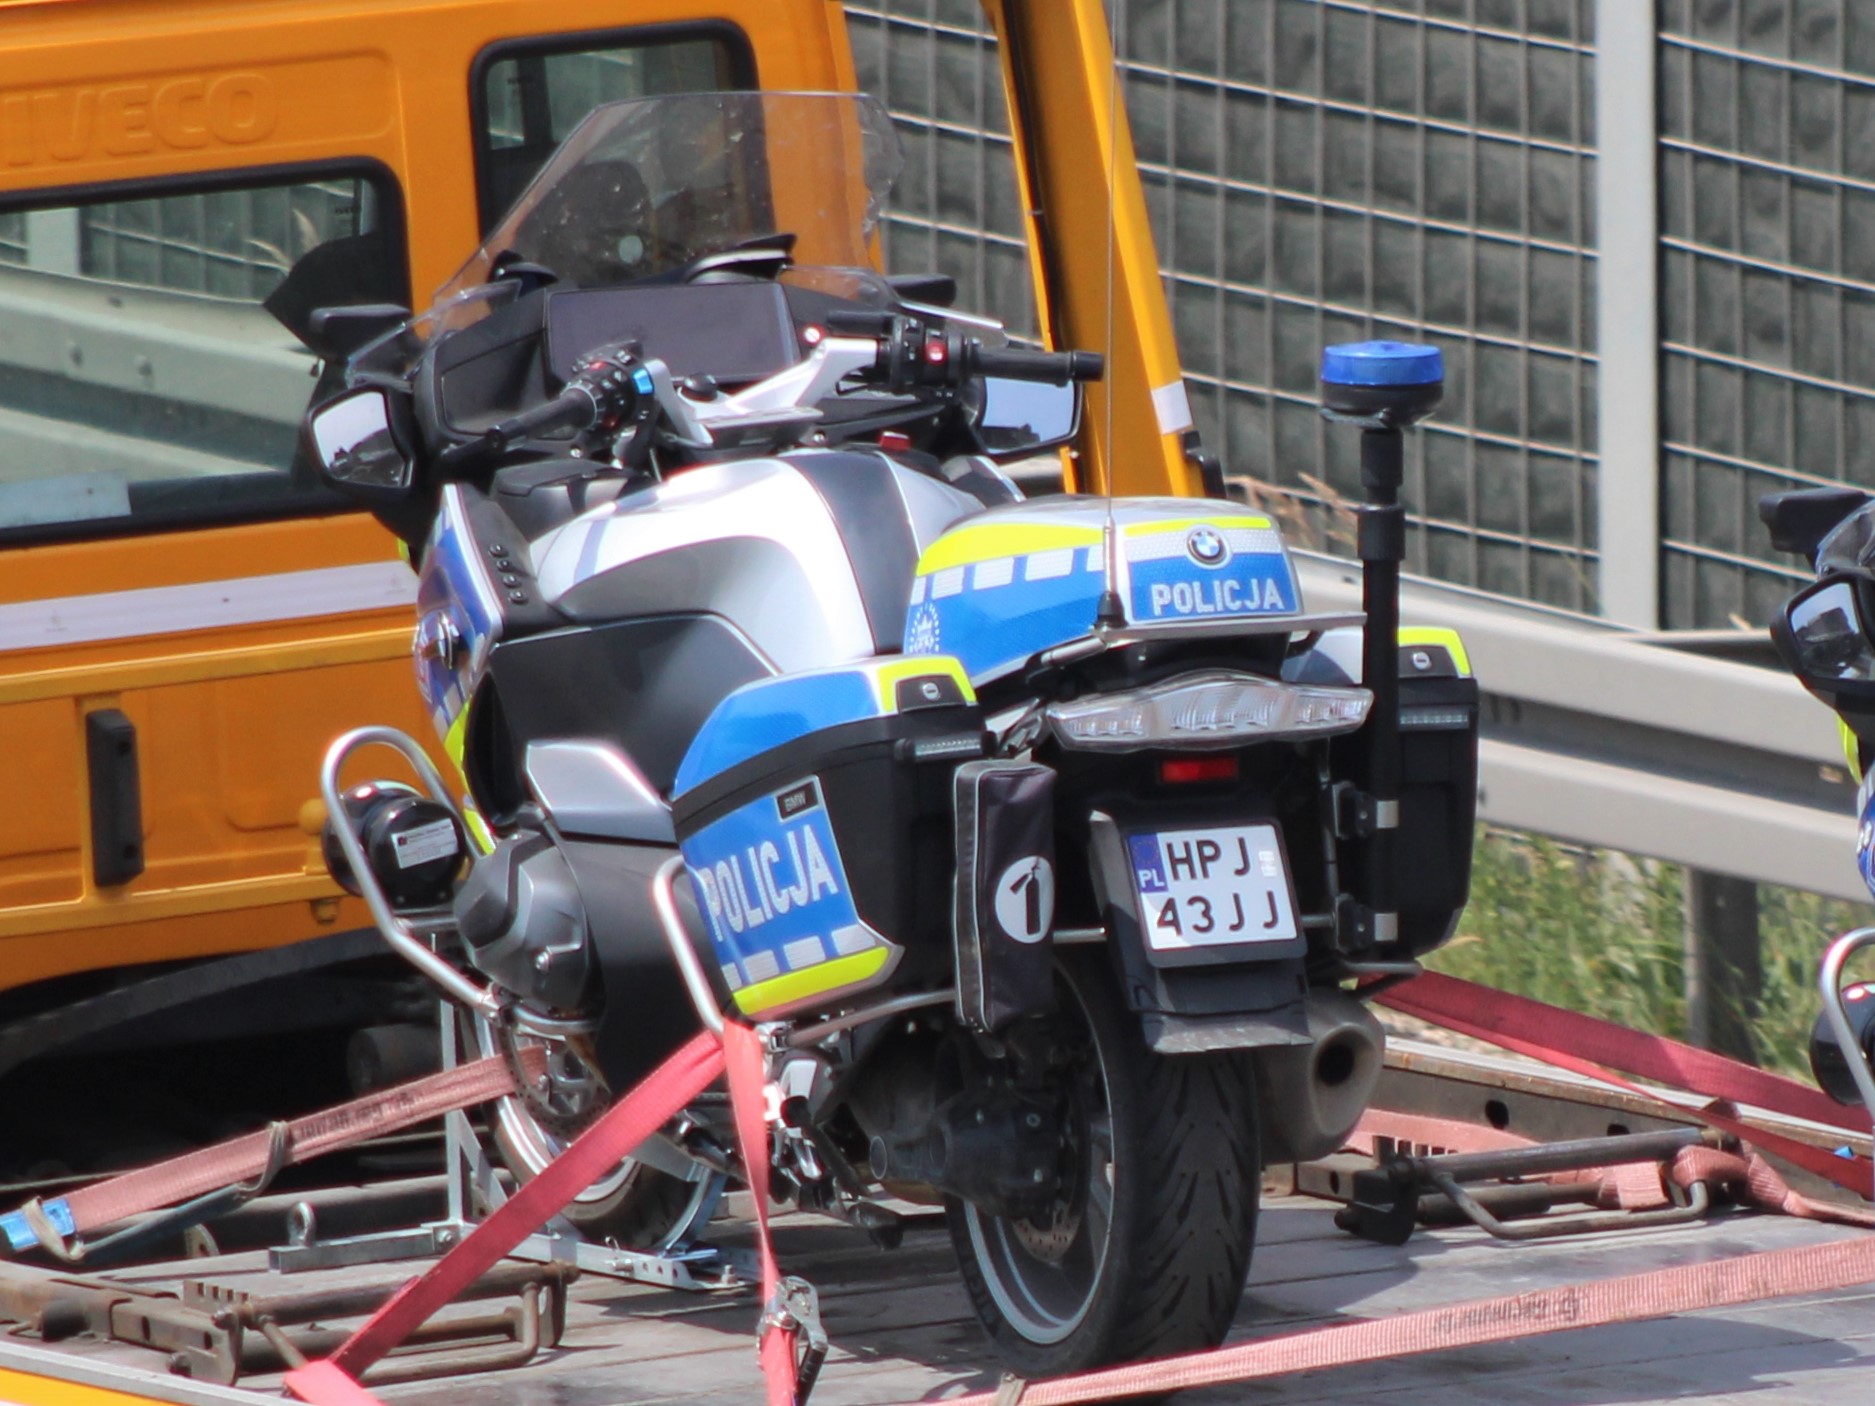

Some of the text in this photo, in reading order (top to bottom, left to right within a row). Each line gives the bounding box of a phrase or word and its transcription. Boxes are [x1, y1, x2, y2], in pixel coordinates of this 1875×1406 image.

[2, 71, 277, 168] IVECO
[1151, 577, 1286, 617] POLICJA
[1138, 868, 1166, 889] PL
[1166, 837, 1251, 881] HPJ
[699, 824, 839, 942] POLICJA
[1156, 890, 1279, 936] 43JJ
